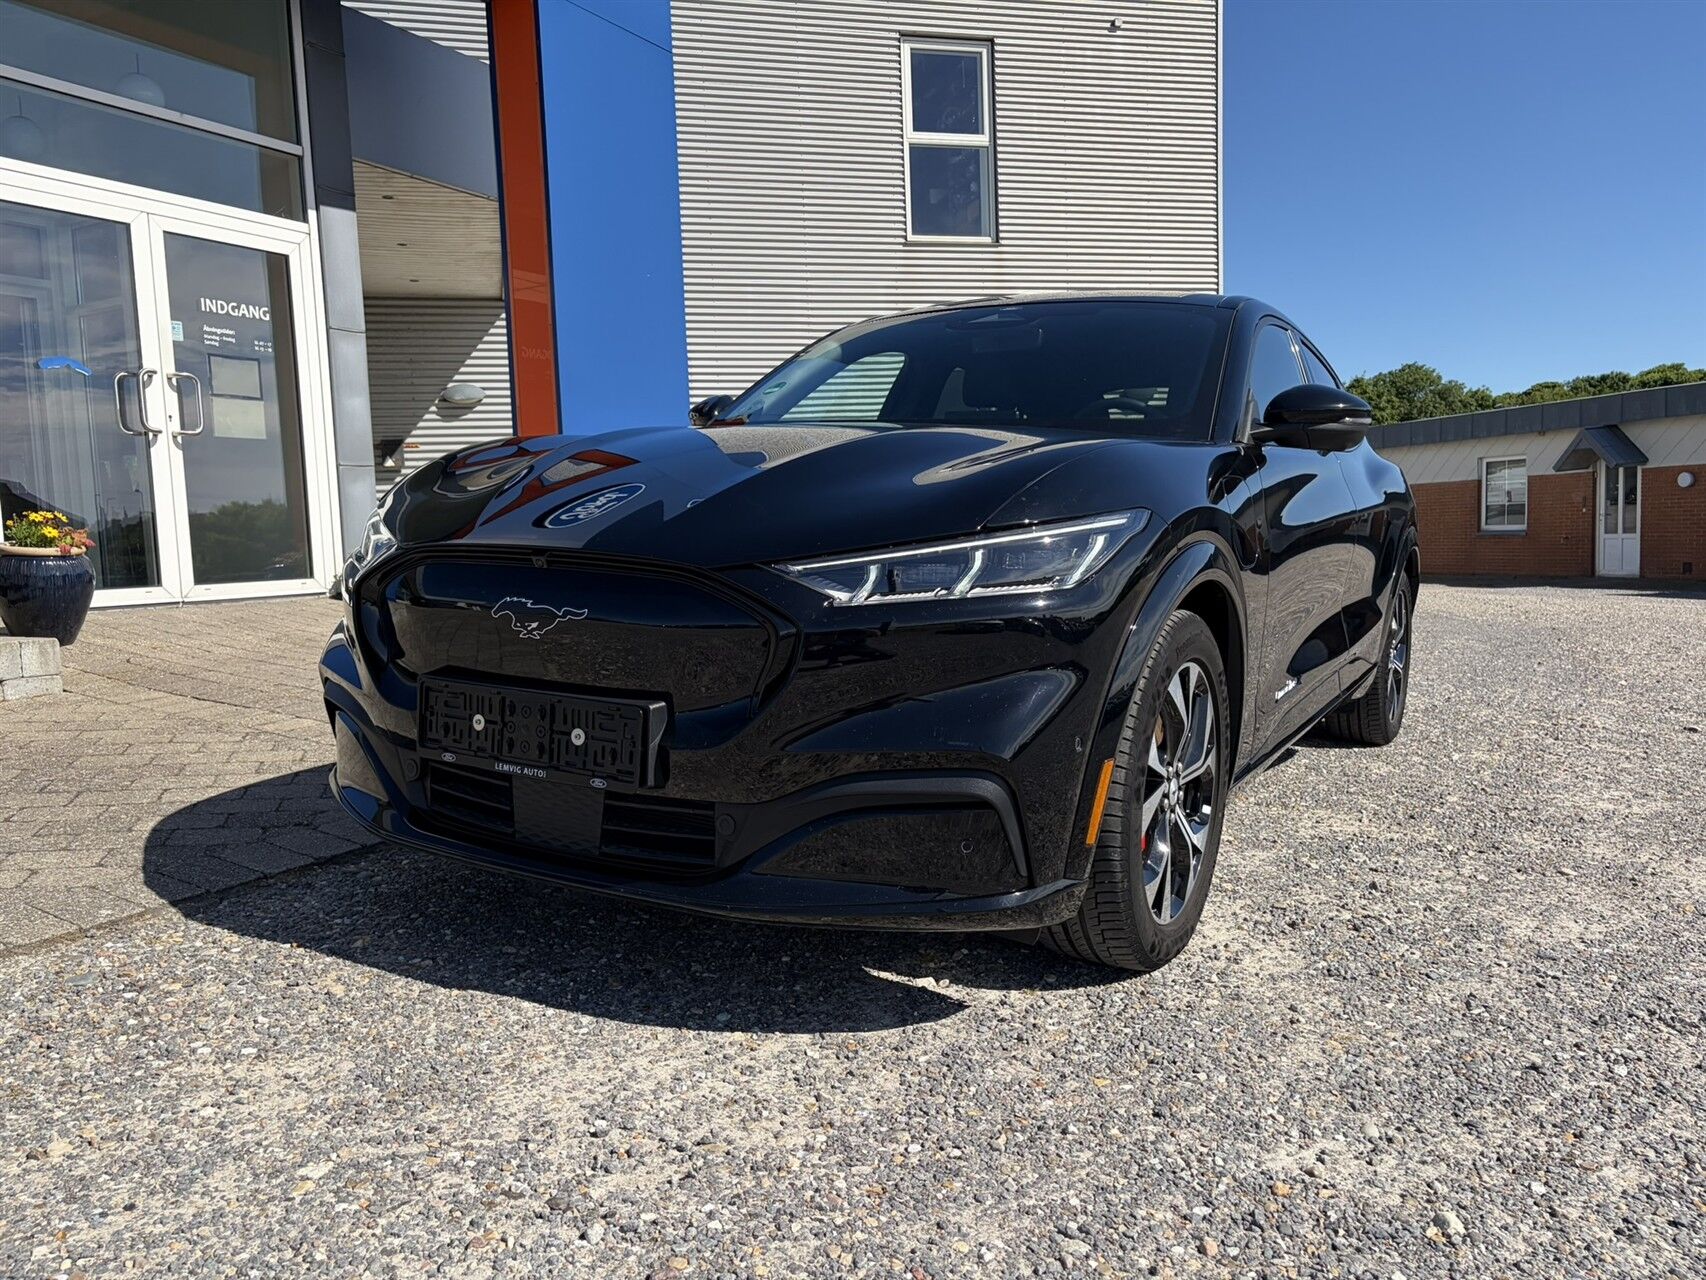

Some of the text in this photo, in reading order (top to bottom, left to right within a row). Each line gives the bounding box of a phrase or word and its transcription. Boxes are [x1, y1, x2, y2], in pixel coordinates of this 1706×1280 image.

[200, 297, 270, 321] INDGANG
[560, 491, 629, 520] Ford
[494, 762, 522, 774] LEMVIG
